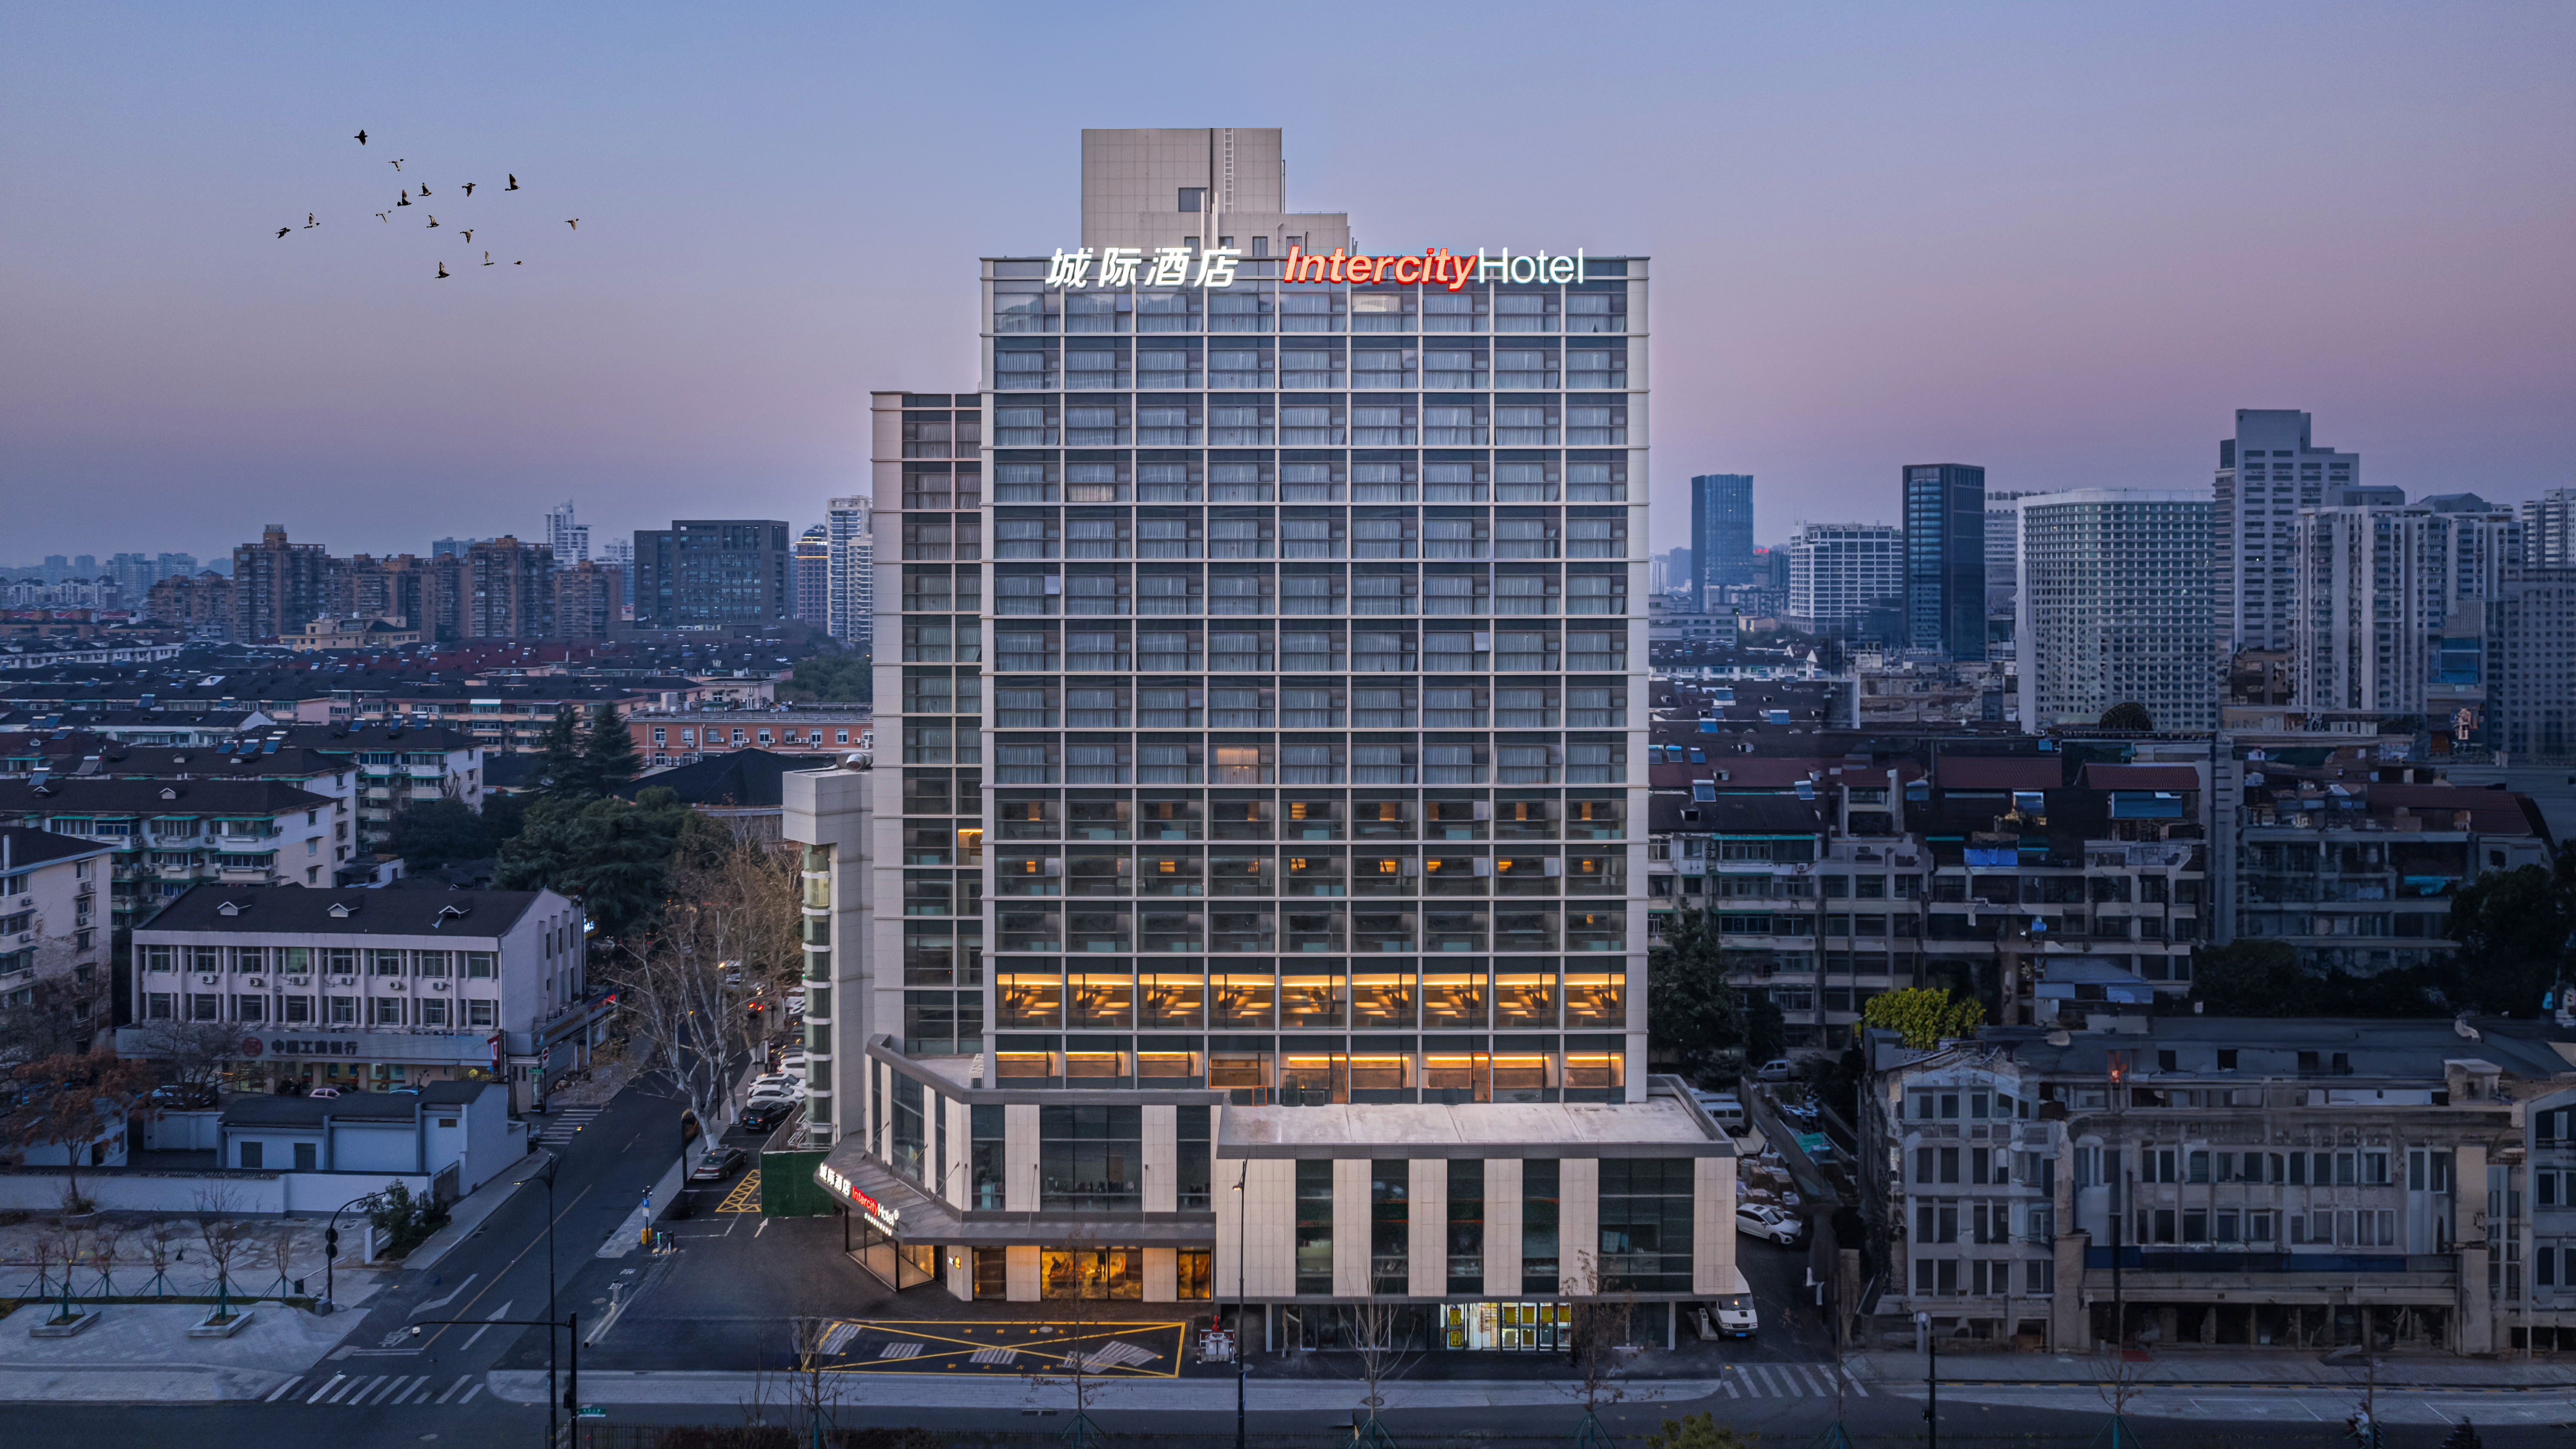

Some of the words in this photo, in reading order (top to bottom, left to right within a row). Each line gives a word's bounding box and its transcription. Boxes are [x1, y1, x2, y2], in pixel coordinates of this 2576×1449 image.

[1045, 246, 1242, 289] 城际酒店
[1283, 245, 1584, 291] IntercityHotel
